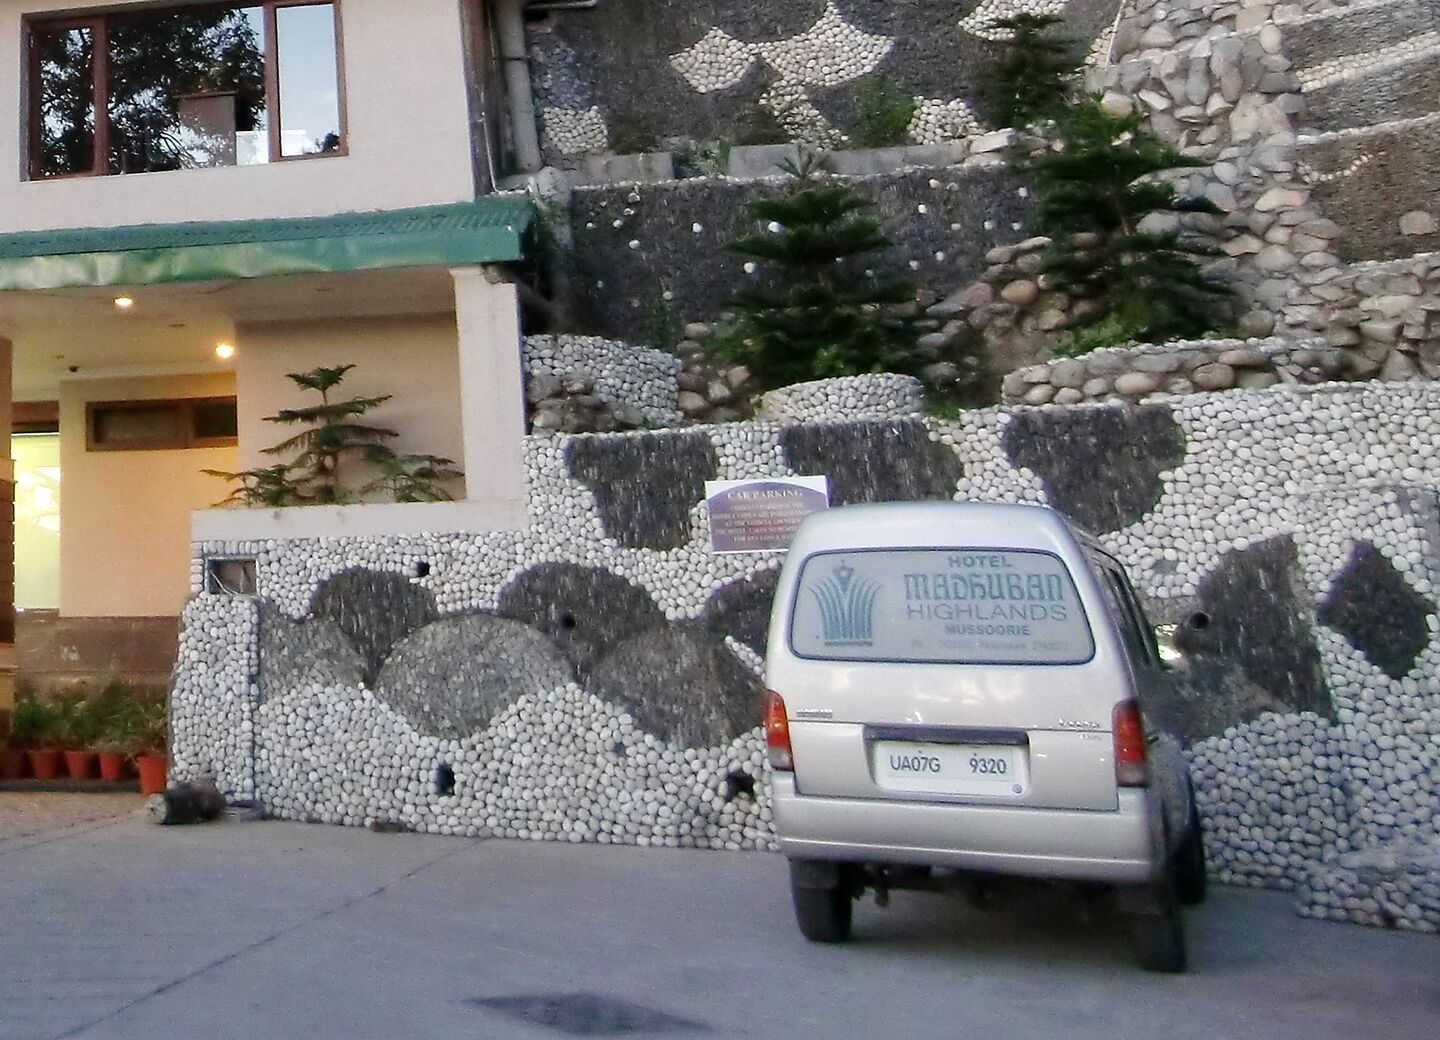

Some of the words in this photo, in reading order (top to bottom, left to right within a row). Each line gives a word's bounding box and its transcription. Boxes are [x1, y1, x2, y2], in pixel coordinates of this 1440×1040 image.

[752, 489, 803, 499] PARKING
[947, 555, 1012, 568] HOTEL
[904, 573, 1064, 601] MADHUBAN
[907, 603, 1067, 621] HIGHLANDS
[945, 624, 1031, 636] MUSSOORIE
[889, 755, 940, 773] UA07G
[969, 758, 1007, 774] 9320
